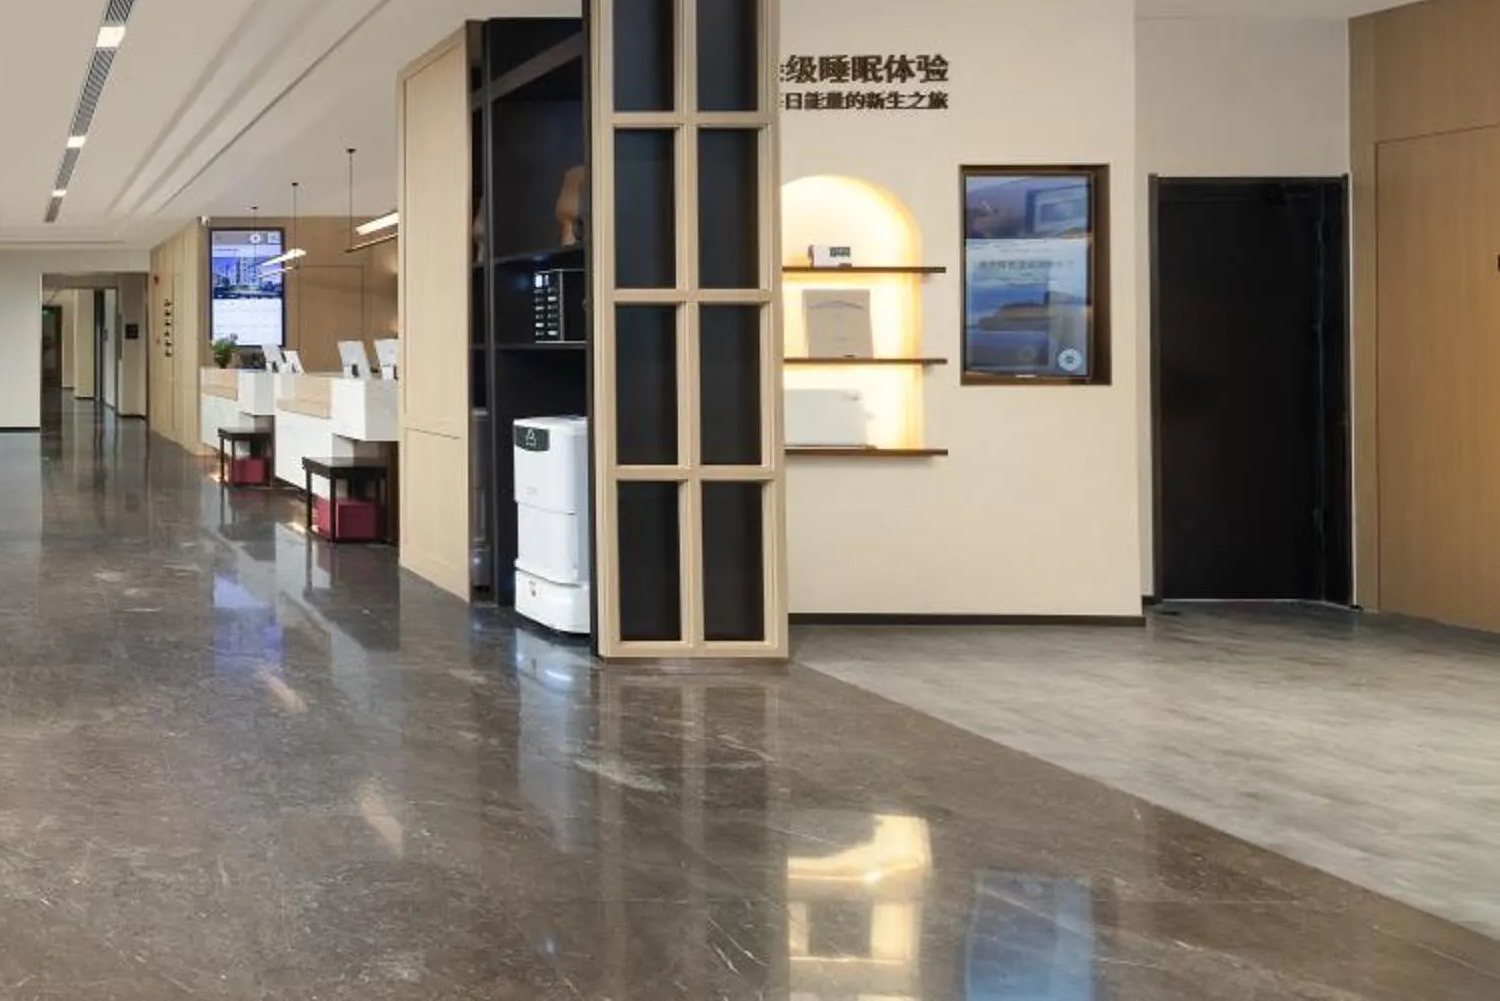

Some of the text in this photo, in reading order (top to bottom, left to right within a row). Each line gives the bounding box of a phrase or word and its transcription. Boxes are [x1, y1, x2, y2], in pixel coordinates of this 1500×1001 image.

[780, 54, 948, 83] 级睡眠体验
[780, 91, 948, 110] 日能量的新生之旅
